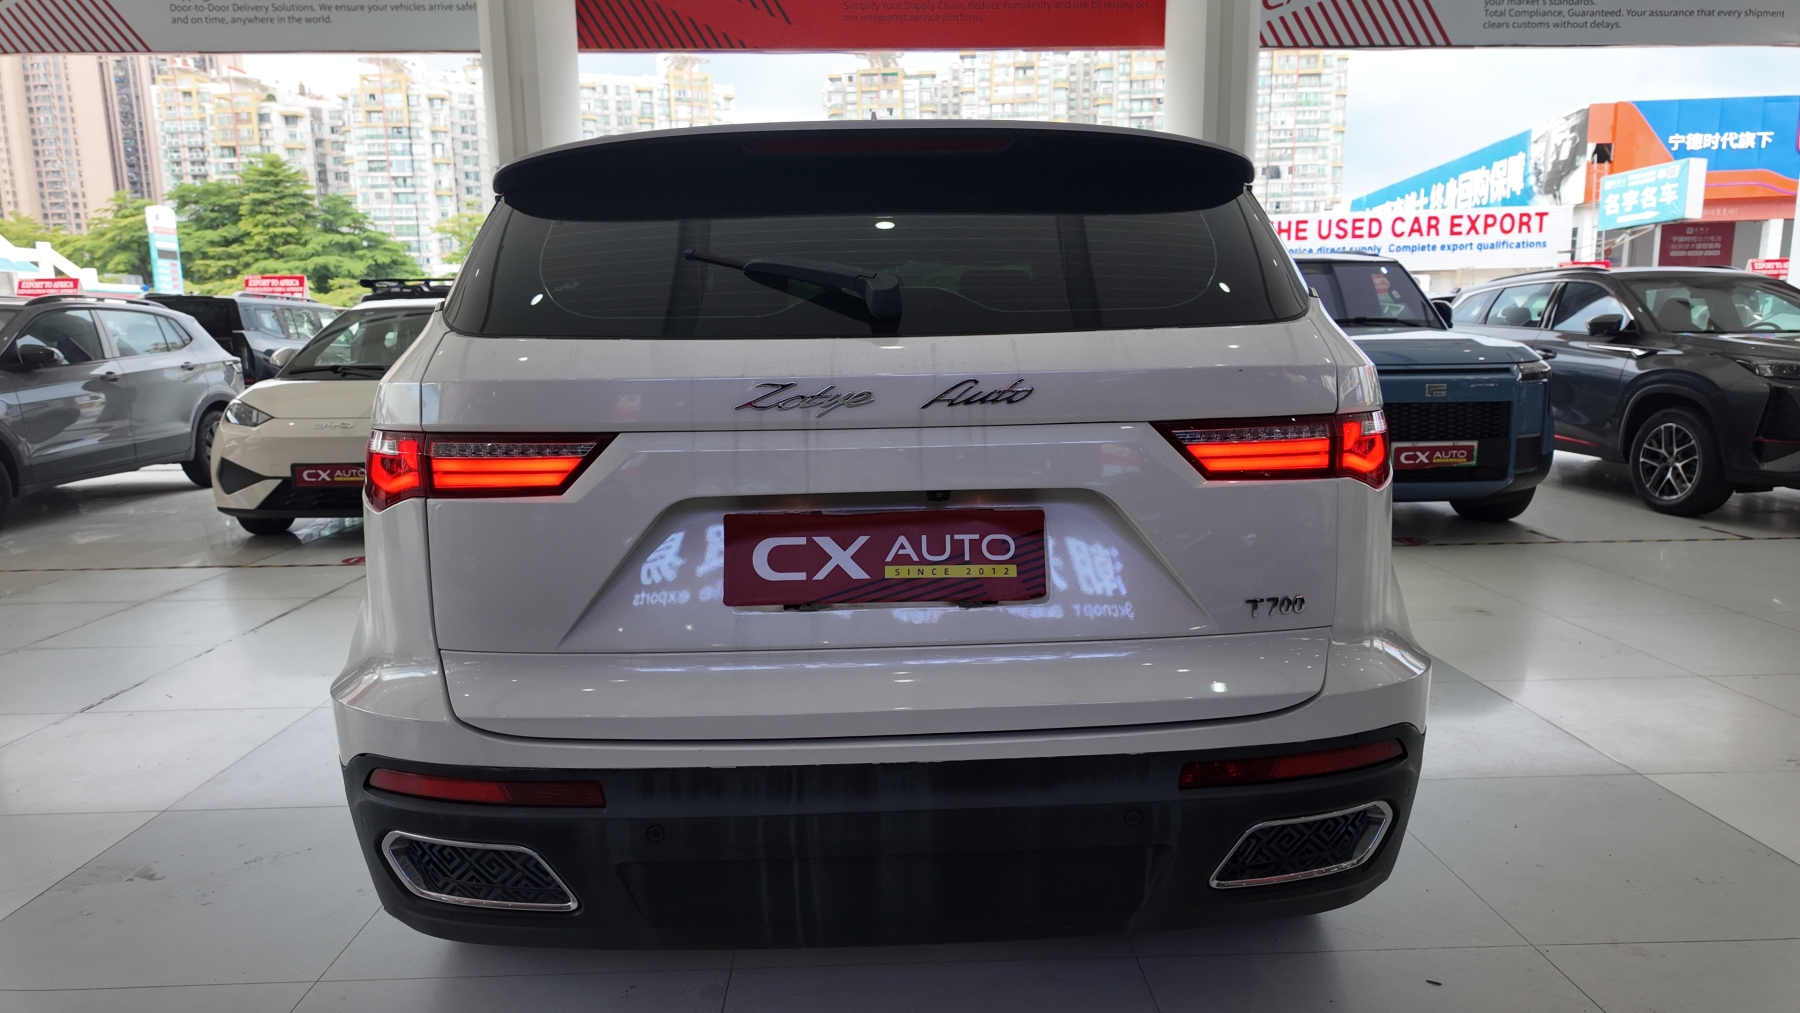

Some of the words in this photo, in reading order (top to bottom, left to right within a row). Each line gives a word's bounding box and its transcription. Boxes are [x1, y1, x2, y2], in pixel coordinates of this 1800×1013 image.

[169, 3, 230, 12] Door-to-Door
[232, 3, 270, 14] Delivery
[271, 3, 317, 12] Solutions.
[318, 3, 333, 12] We
[335, 4, 365, 12] ensure
[368, 4, 388, 14] your
[389, 3, 427, 12] vehicles
[428, 3, 454, 11] arrive
[455, 2, 478, 11] safel
[843, 1, 880, 10] Simplify
[882, 1, 901, 9] Your
[905, 1, 935, 10] Supply
[937, 1, 965, 9] Chain.
[968, 1, 1000, 9] Reduce
[1003, 0, 1051, 10] complexity
[1054, 0, 1071, 9] and
[1073, 0, 1089, 9] risk
[1091, 0, 1102, 10] by
[1104, 0, 1134, 10] relying
[843, 14, 859, 22] our
[860, 12, 907, 24] integrated
[908, 13, 940, 22] service
[942, 12, 983, 23] platform.
[1484, 8, 1506, 17] Total
[1508, 8, 1566, 19] Compliance,
[1567, 8, 1624, 17] Guaranteed.
[1626, 8, 1647, 17] Your
[1696, 8, 1715, 17] that
[1717, 10, 1743, 19] every
[1743, 8, 1785, 18] shipment
[171, 15, 189, 24] and
[204, 15, 229, 25] time,
[230, 15, 275, 26] anywhere
[277, 15, 286, 24] in
[287, 15, 301, 24] the
[304, 15, 333, 24] world.
[1482, 20, 1510, 29] clears
[1511, 20, 1550, 29] customs
[1552, 20, 1588, 29] without
[1589, 20, 1622, 31] delays.
[1667, 131, 1775, 151] 宁德时代旗下
[1603, 182, 1679, 216] 名宇名车
[1269, 219, 1309, 241] HE
[1317, 217, 1383, 240] USED
[1390, 216, 1440, 238] CAR
[1449, 212, 1549, 236] EXPORT
[1388, 242, 1437, 254] Complete
[1440, 242, 1474, 253] export
[1476, 239, 1547, 253] qualifications
[733, 381, 875, 418] Zotye
[919, 377, 1035, 409] Auto
[313, 422, 354, 430] BYD
[1400, 451, 1431, 464] CX
[1433, 450, 1468, 459] AUTO
[302, 469, 332, 481] CX
[334, 469, 366, 477] AUTO
[752, 535, 872, 581] CX
[884, 533, 1016, 562] AUTO
[894, 566, 950, 577] SINCE
[966, 566, 1010, 576] 2012
[1245, 594, 1306, 618] T700
